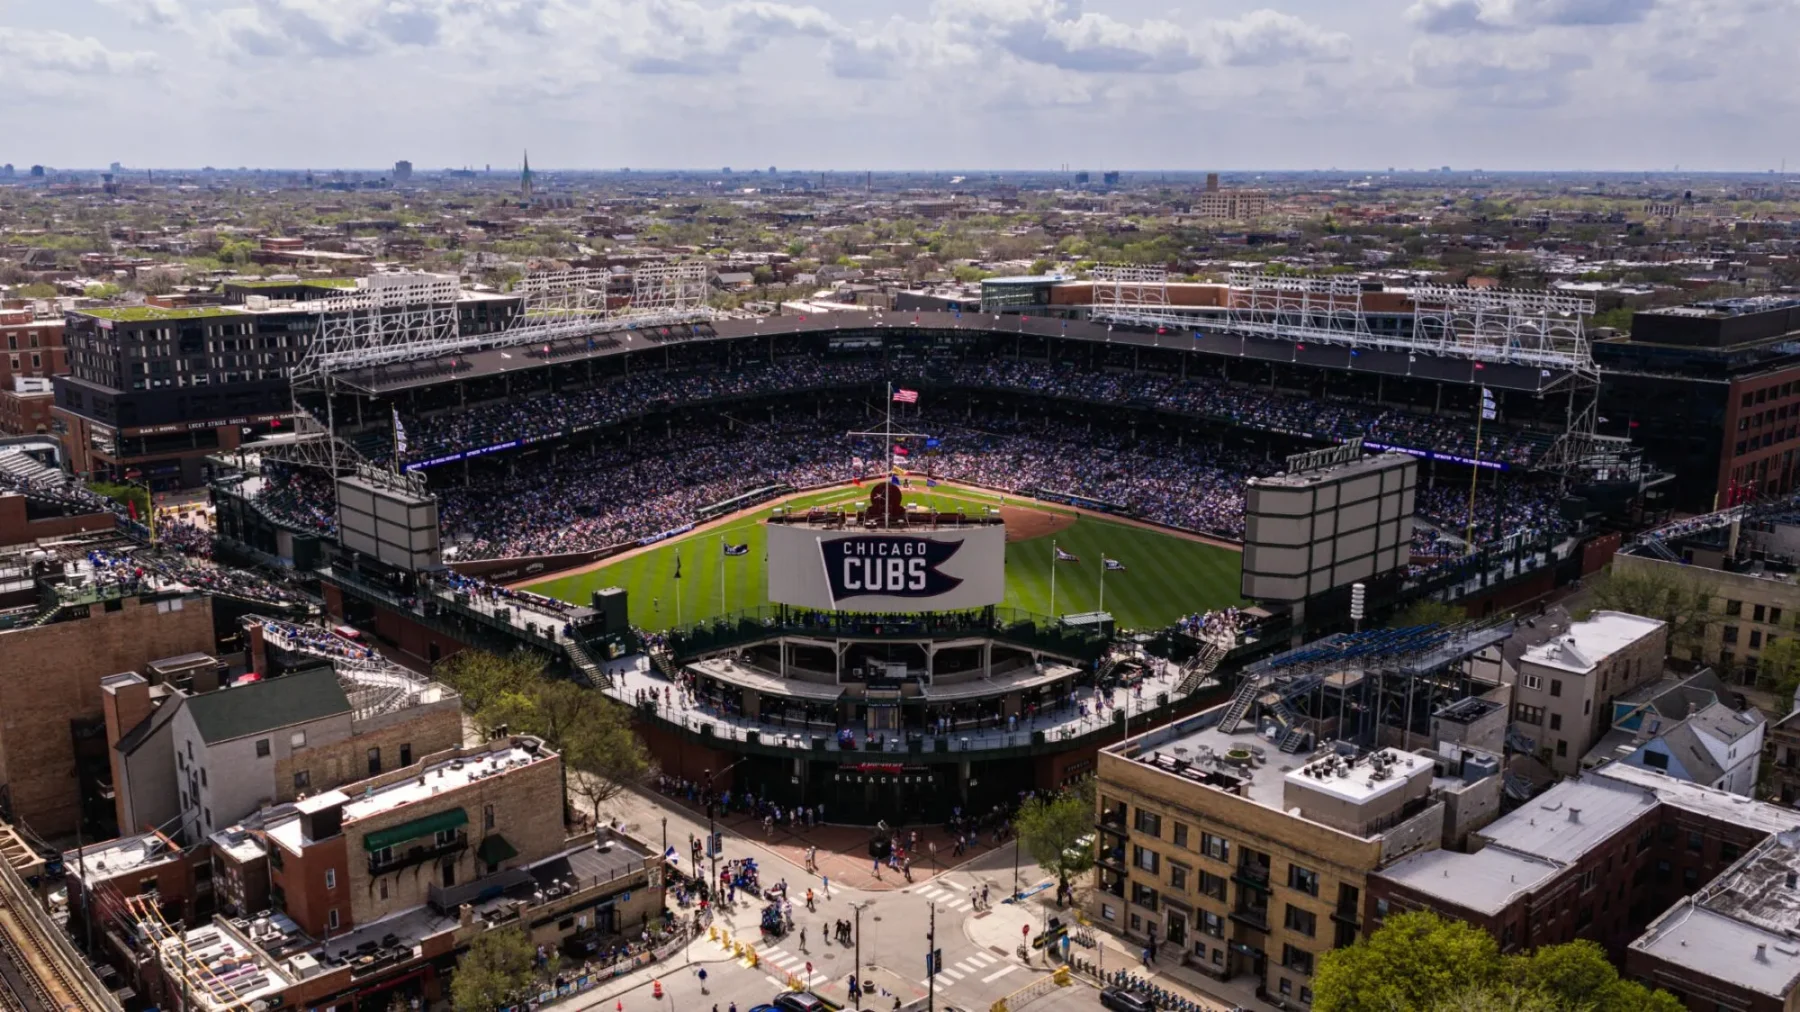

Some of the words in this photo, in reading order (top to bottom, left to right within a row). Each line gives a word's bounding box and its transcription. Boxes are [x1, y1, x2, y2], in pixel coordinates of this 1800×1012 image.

[843, 541, 926, 556] CHICAGO
[843, 557, 926, 591] CUBS
[834, 773, 933, 784] BLEACHERS
